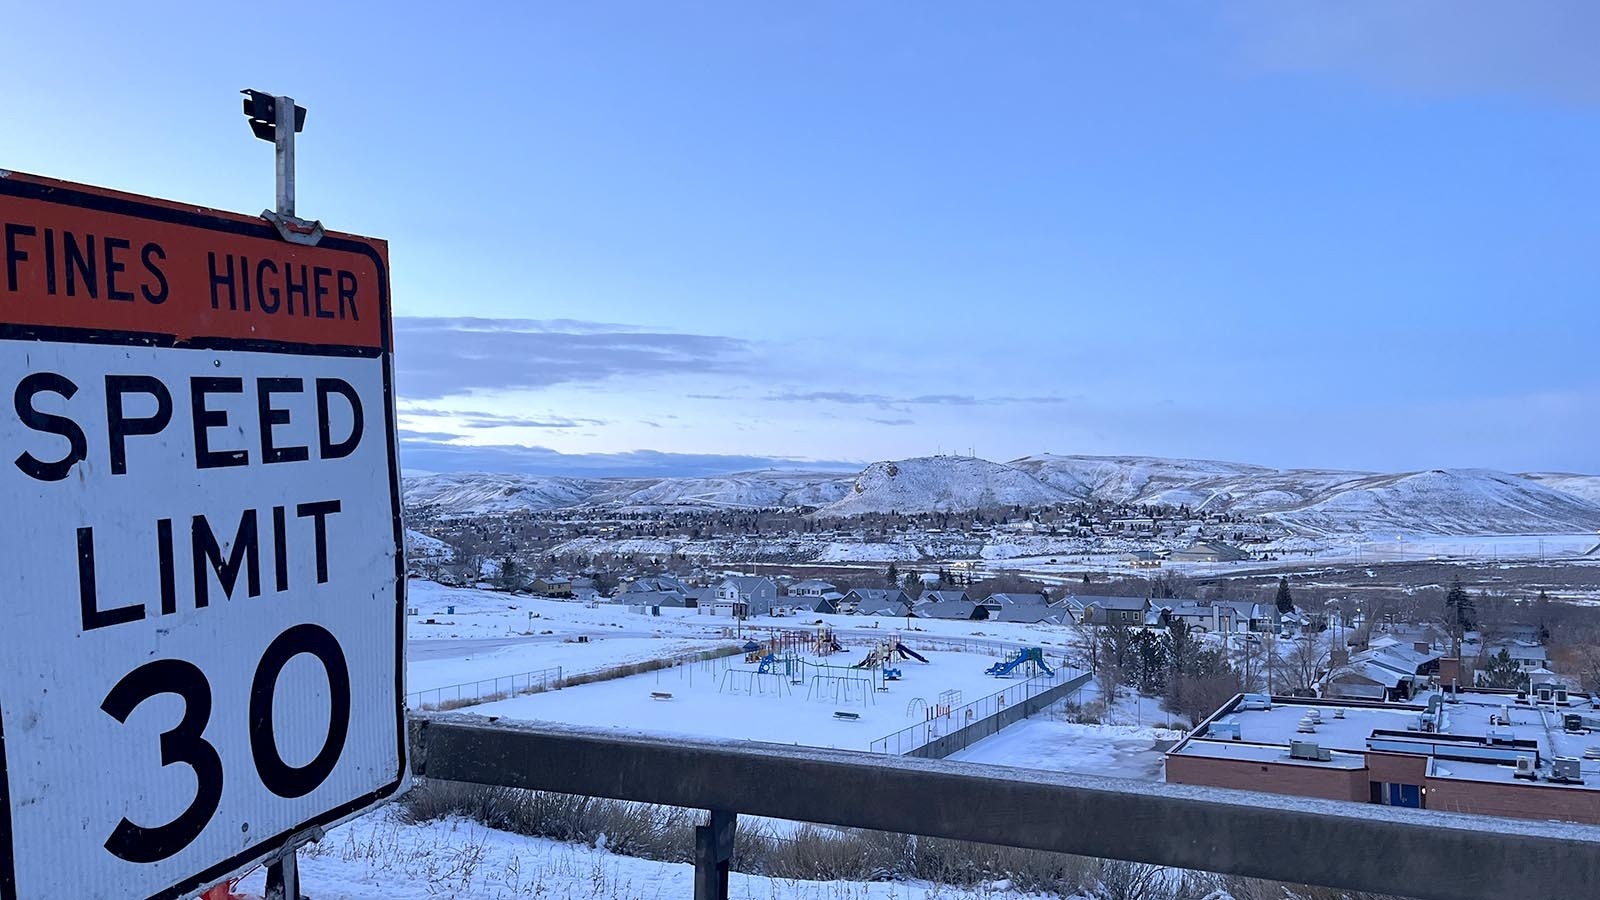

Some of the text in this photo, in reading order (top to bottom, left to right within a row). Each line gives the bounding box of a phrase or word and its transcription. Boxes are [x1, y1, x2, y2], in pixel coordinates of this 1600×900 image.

[5, 222, 360, 321] FINES HIGHER
[14, 371, 364, 482] SPEED
[76, 499, 341, 631] LIMIT
[100, 623, 351, 863] 30
